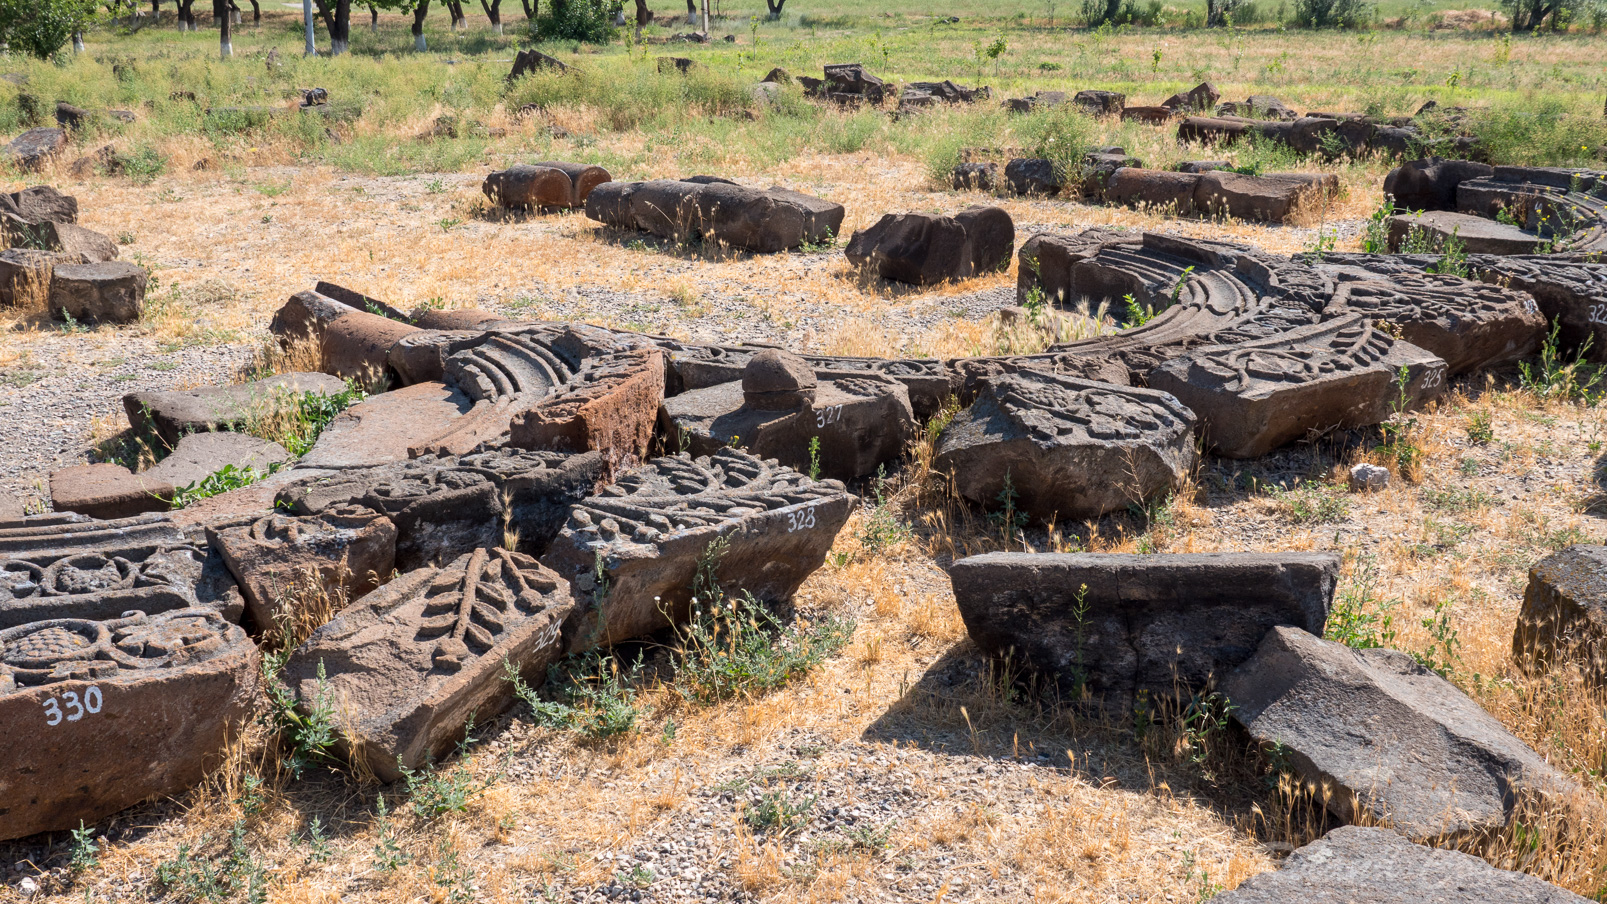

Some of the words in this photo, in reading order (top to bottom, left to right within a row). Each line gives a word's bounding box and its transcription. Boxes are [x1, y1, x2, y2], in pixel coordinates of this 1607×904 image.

[1421, 368, 1445, 390] 325
[816, 404, 843, 428] 327
[787, 506, 816, 533] 328
[532, 618, 562, 653] 329
[42, 685, 103, 726] 330
